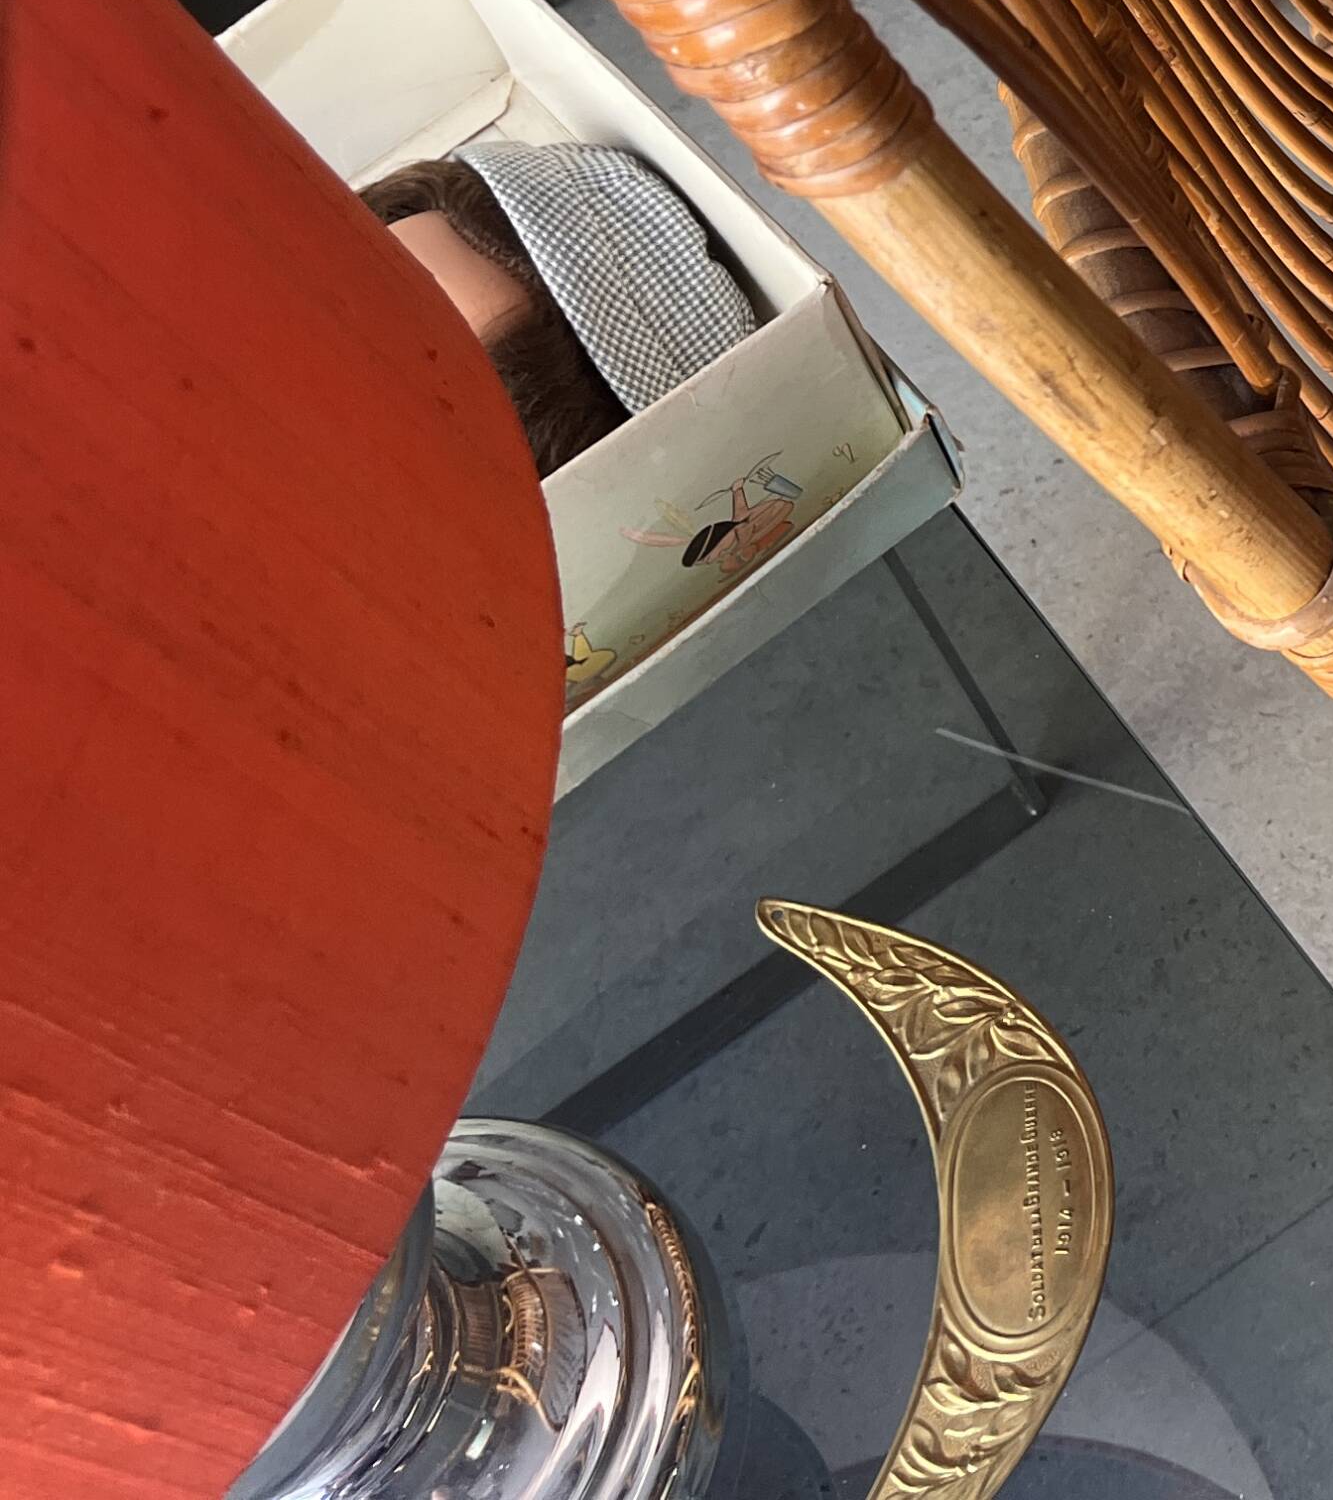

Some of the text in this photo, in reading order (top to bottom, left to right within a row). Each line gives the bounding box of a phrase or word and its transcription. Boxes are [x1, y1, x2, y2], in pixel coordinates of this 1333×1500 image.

[1019, 1082, 1038, 1144] GUERRE
[1022, 1144, 1041, 1210] GRANDE
[1049, 1130, 1072, 1172] 1918
[1054, 1208, 1074, 1255] 1914
[1026, 1251, 1046, 1322] SOLDAT
